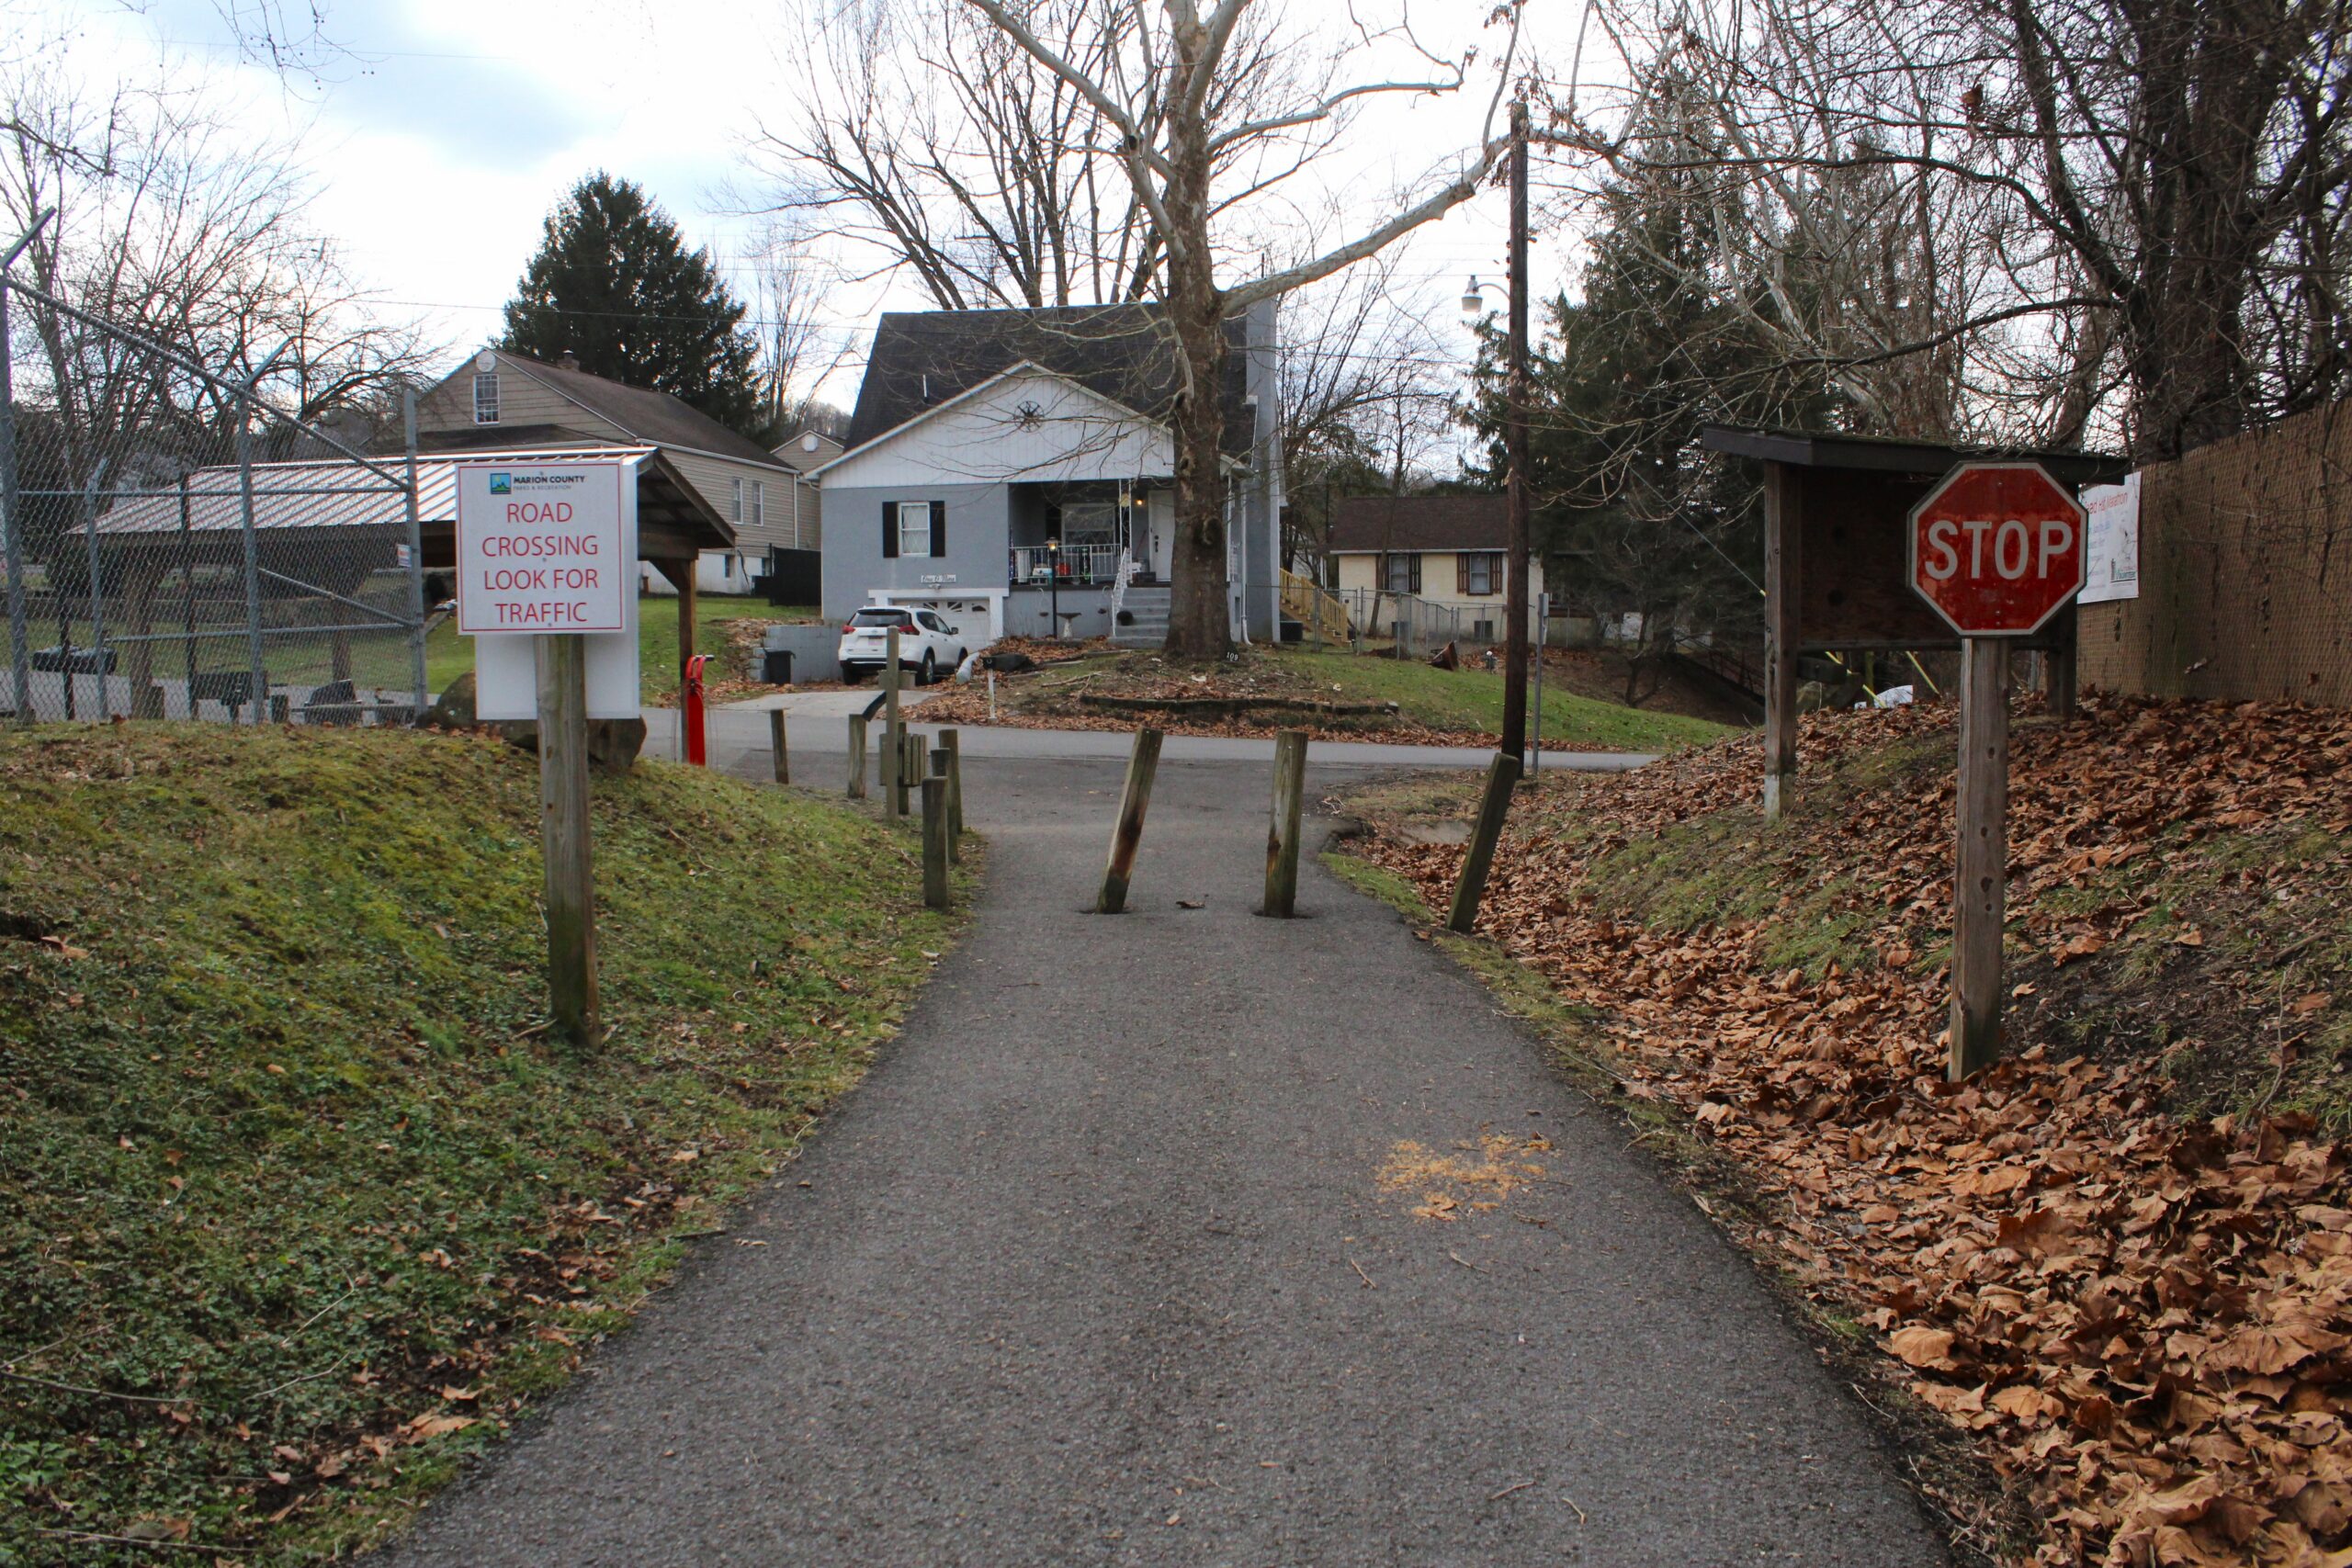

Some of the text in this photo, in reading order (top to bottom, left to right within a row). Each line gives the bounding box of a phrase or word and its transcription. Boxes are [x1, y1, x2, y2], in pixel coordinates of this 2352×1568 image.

[514, 475, 585, 484] MARION COUNTY
[506, 502, 573, 524] ROAD
[481, 535, 598, 557] CROSSING
[1925, 520, 2073, 580] STOP
[484, 569, 599, 591] LOOK FOR
[494, 602, 588, 623] TRAFFIC
